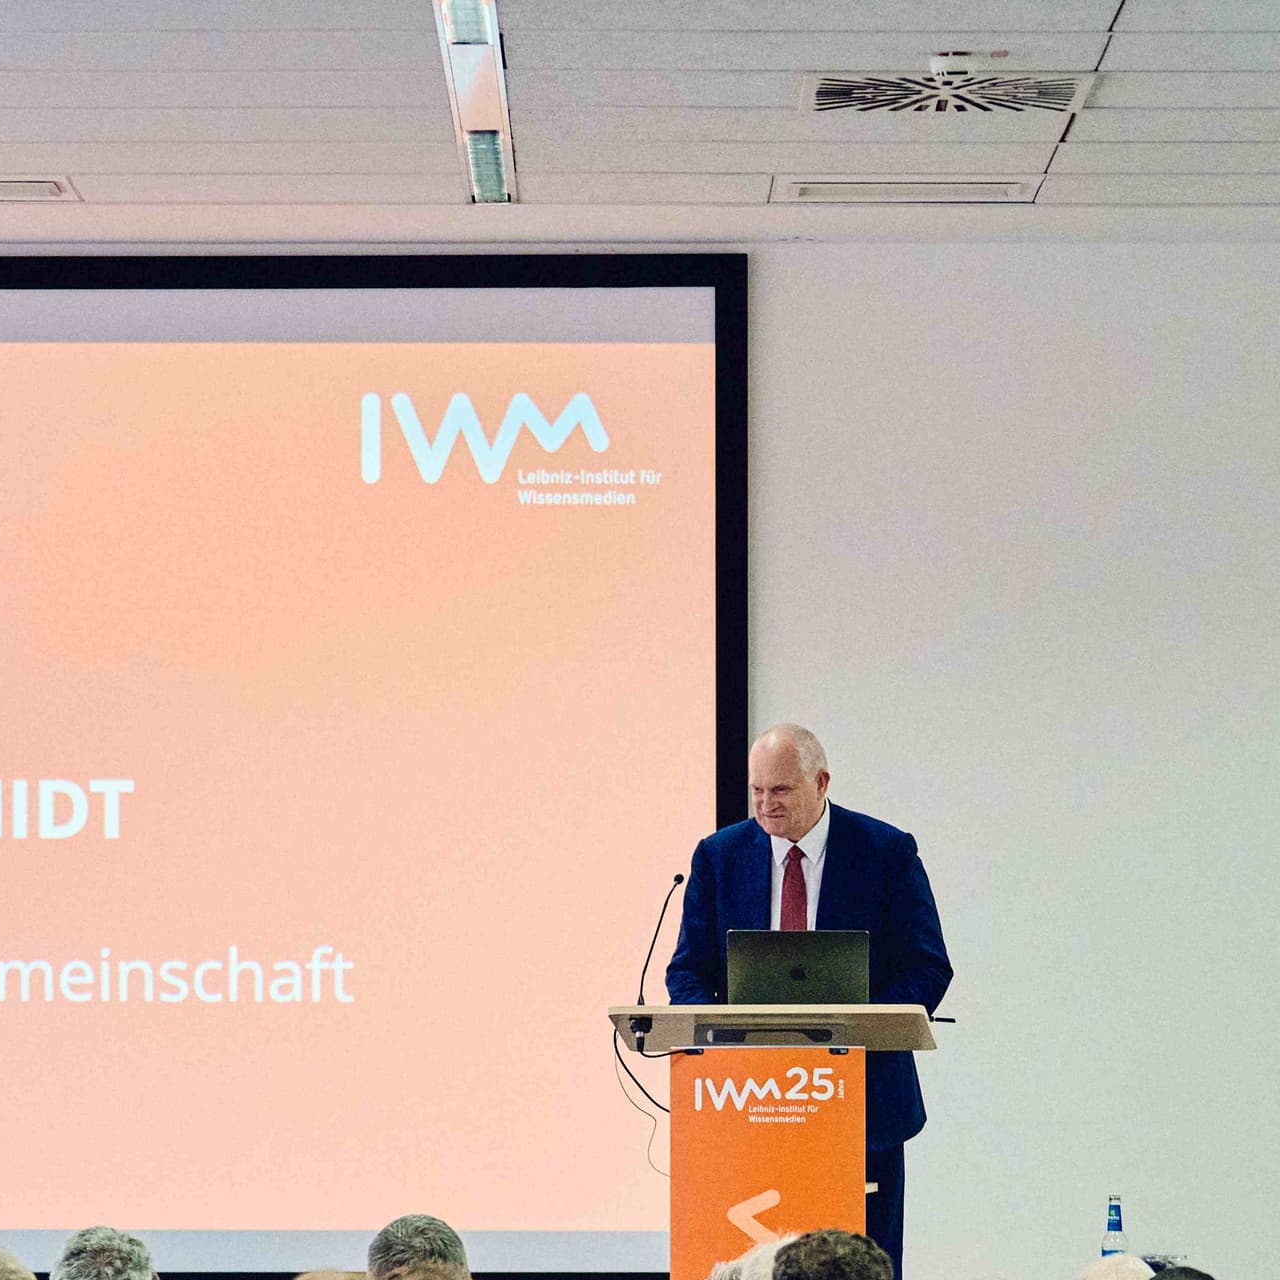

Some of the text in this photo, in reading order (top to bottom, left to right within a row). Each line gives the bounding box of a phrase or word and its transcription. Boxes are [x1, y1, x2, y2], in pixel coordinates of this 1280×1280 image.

[361, 392, 610, 484] IWM
[518, 469, 663, 485] Leibniz-Institut für
[518, 489, 636, 505] Wissensmedien
[785, 1066, 835, 1101] 25
[748, 1104, 819, 1113] Leibniz-Institut für
[748, 1115, 806, 1123] Wissensmedien
